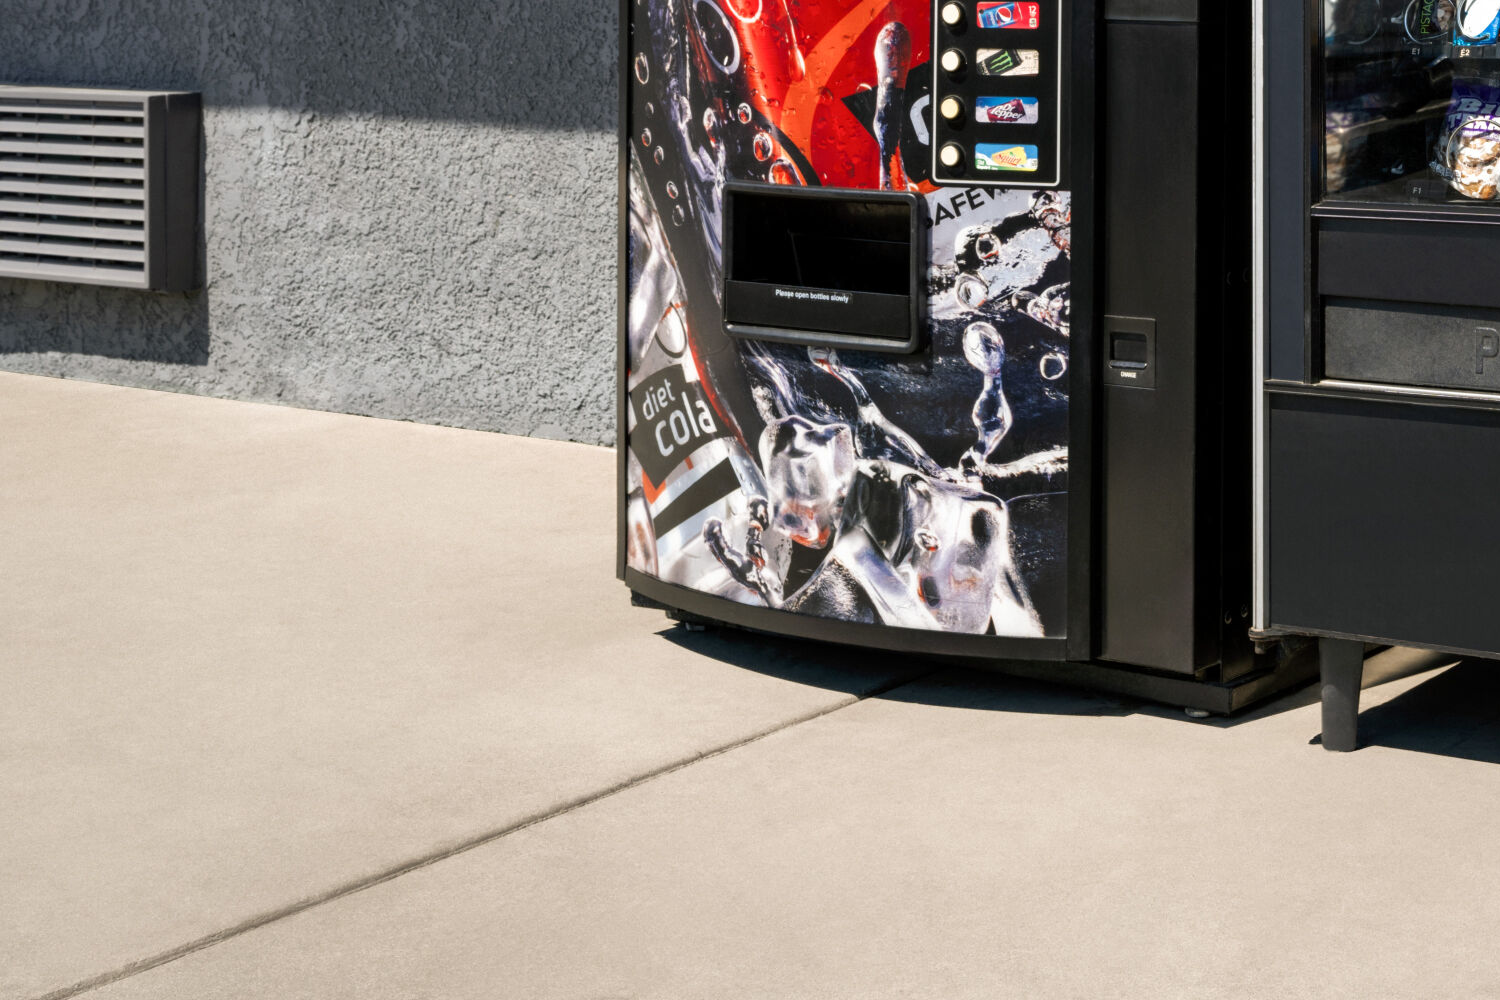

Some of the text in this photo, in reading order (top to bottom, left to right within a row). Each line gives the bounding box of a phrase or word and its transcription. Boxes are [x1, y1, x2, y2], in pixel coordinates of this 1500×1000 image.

[1028, 6, 1037, 14] 12
[1460, 48, 1470, 57] E2
[990, 105, 1023, 120] Pepper
[1003, 102, 1016, 112] Dr
[1412, 186, 1422, 194] F1
[775, 289, 849, 304] Please open bottles slowly
[642, 378, 676, 421] diet
[655, 391, 718, 457] cola
